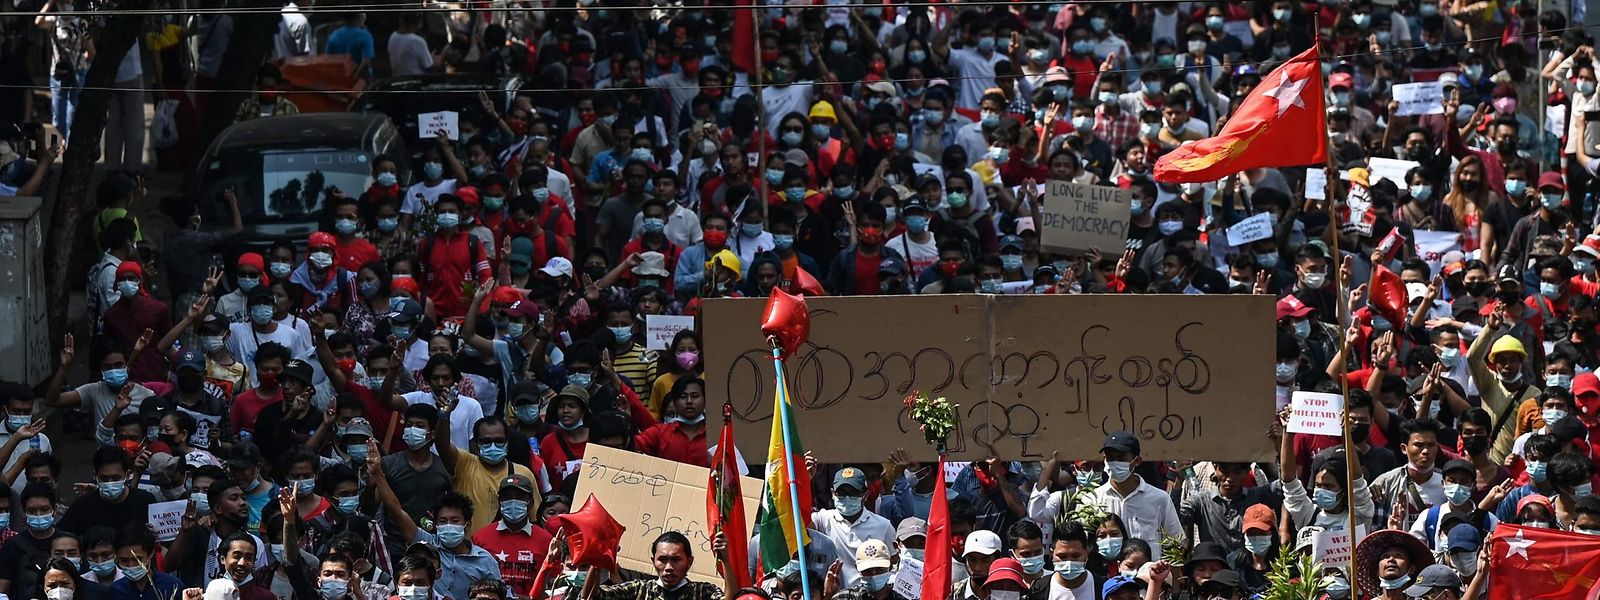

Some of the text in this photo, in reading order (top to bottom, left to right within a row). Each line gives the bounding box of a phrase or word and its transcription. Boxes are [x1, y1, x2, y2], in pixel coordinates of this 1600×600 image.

[1052, 183, 1122, 203] LONG LIVE
[1074, 199, 1099, 214] THE
[1043, 212, 1129, 240] DEMOCRACY
[1303, 398, 1329, 407] STOP
[1294, 409, 1338, 419] MILITARY
[1301, 420, 1325, 428] COUP
[1331, 535, 1349, 544] WE
[1321, 555, 1351, 563] JUSTIC
[898, 578, 913, 591] FREE
